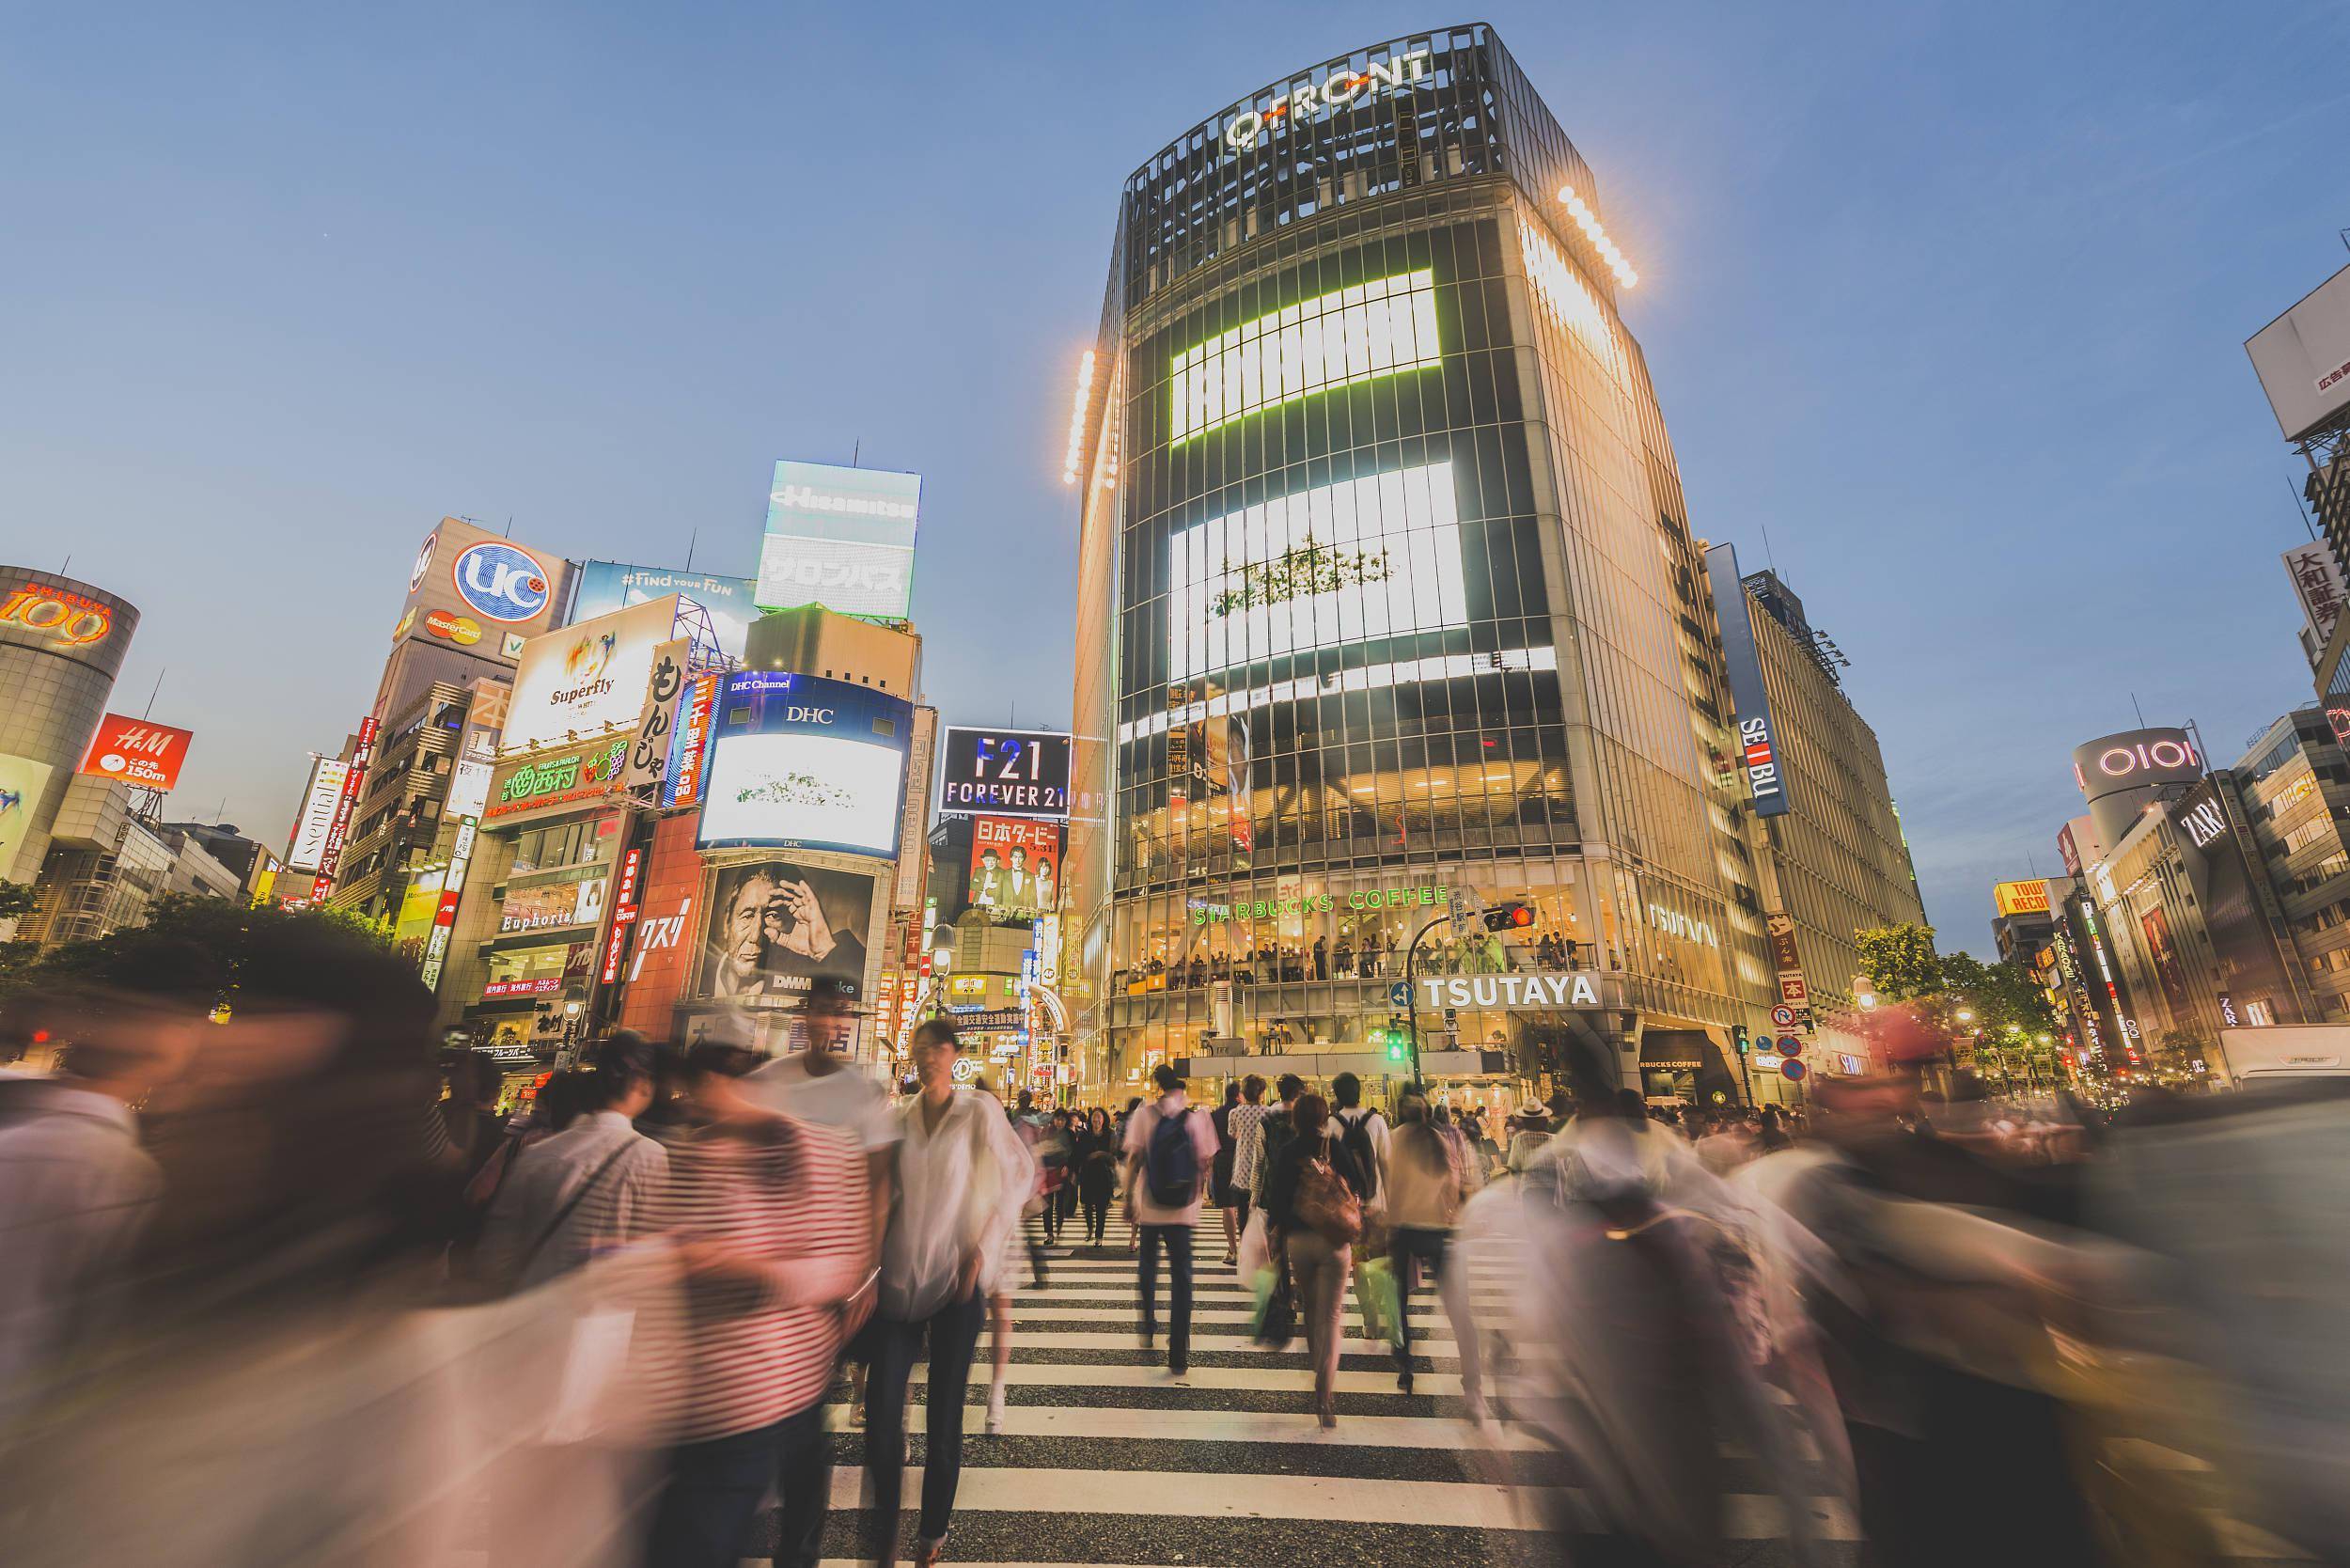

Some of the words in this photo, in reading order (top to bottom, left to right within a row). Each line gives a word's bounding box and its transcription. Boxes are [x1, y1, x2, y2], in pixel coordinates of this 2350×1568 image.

[465, 554, 541, 609] UC
[25, 582, 113, 617] SHIBUYA
[0, 590, 110, 646] 109
[427, 616, 481, 638] MasterCard
[550, 679, 615, 705] Superfly
[731, 681, 751, 692] DHC
[752, 680, 790, 689] Channel
[634, 655, 682, 778] もんじゃ
[787, 706, 834, 724] DHC
[114, 727, 174, 757] H&M
[675, 679, 711, 797] 三千里薬品
[129, 758, 159, 770] この先
[975, 738, 1041, 781] F21
[1740, 717, 1779, 799] SEIBU
[126, 766, 166, 782] 150m
[947, 782, 1039, 807] FOREVER
[1044, 787, 1064, 808] 21
[783, 839, 802, 848] DHC
[978, 820, 1057, 846] 日本ダービー
[2012, 881, 2045, 897] TOW
[1194, 893, 1335, 926] STARBUCKS
[1348, 886, 1448, 910] COFFEE
[906, 920, 921, 964] 三千里
[2053, 932, 2076, 979] KARAOKE
[1423, 976, 1597, 1007] TSUTAYA
[1785, 982, 1804, 997] 本
[2219, 997, 2238, 1027] ZAR
